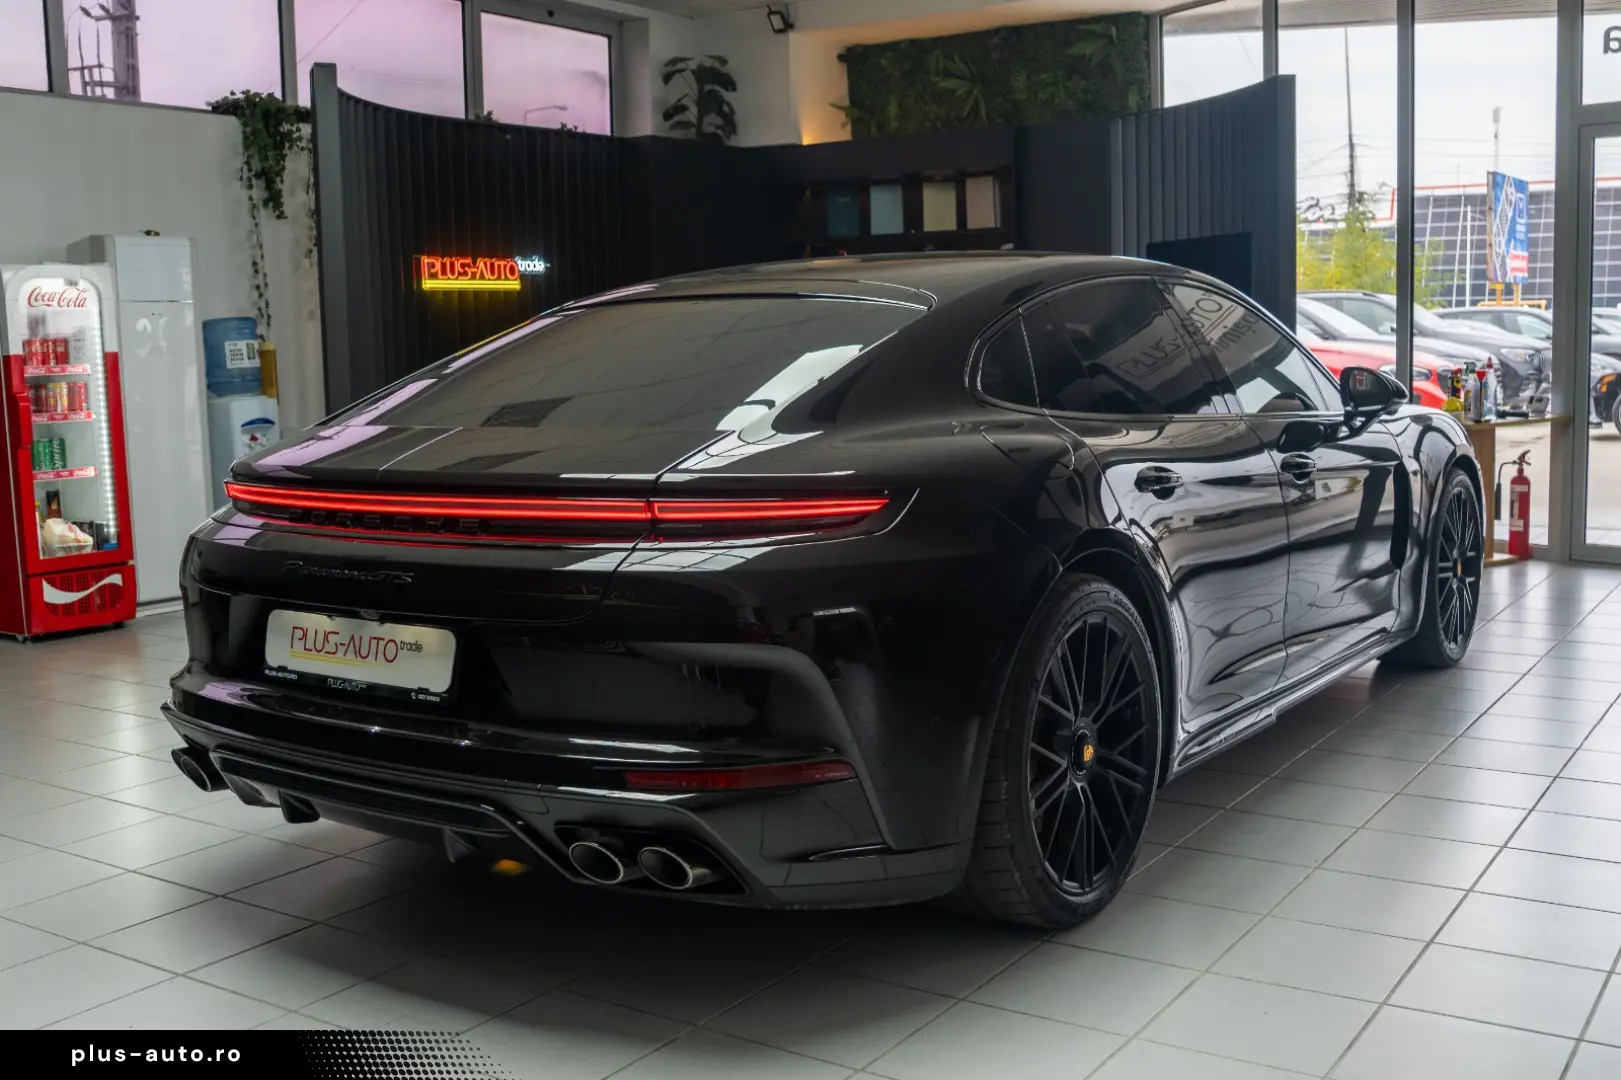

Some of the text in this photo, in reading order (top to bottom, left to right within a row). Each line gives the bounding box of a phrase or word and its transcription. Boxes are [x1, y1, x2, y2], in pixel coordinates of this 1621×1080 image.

[422, 257, 544, 280] PLUS-AUTO trade
[288, 508, 481, 533] PORSCHE
[291, 626, 423, 663] PLUS-AUTO trade
